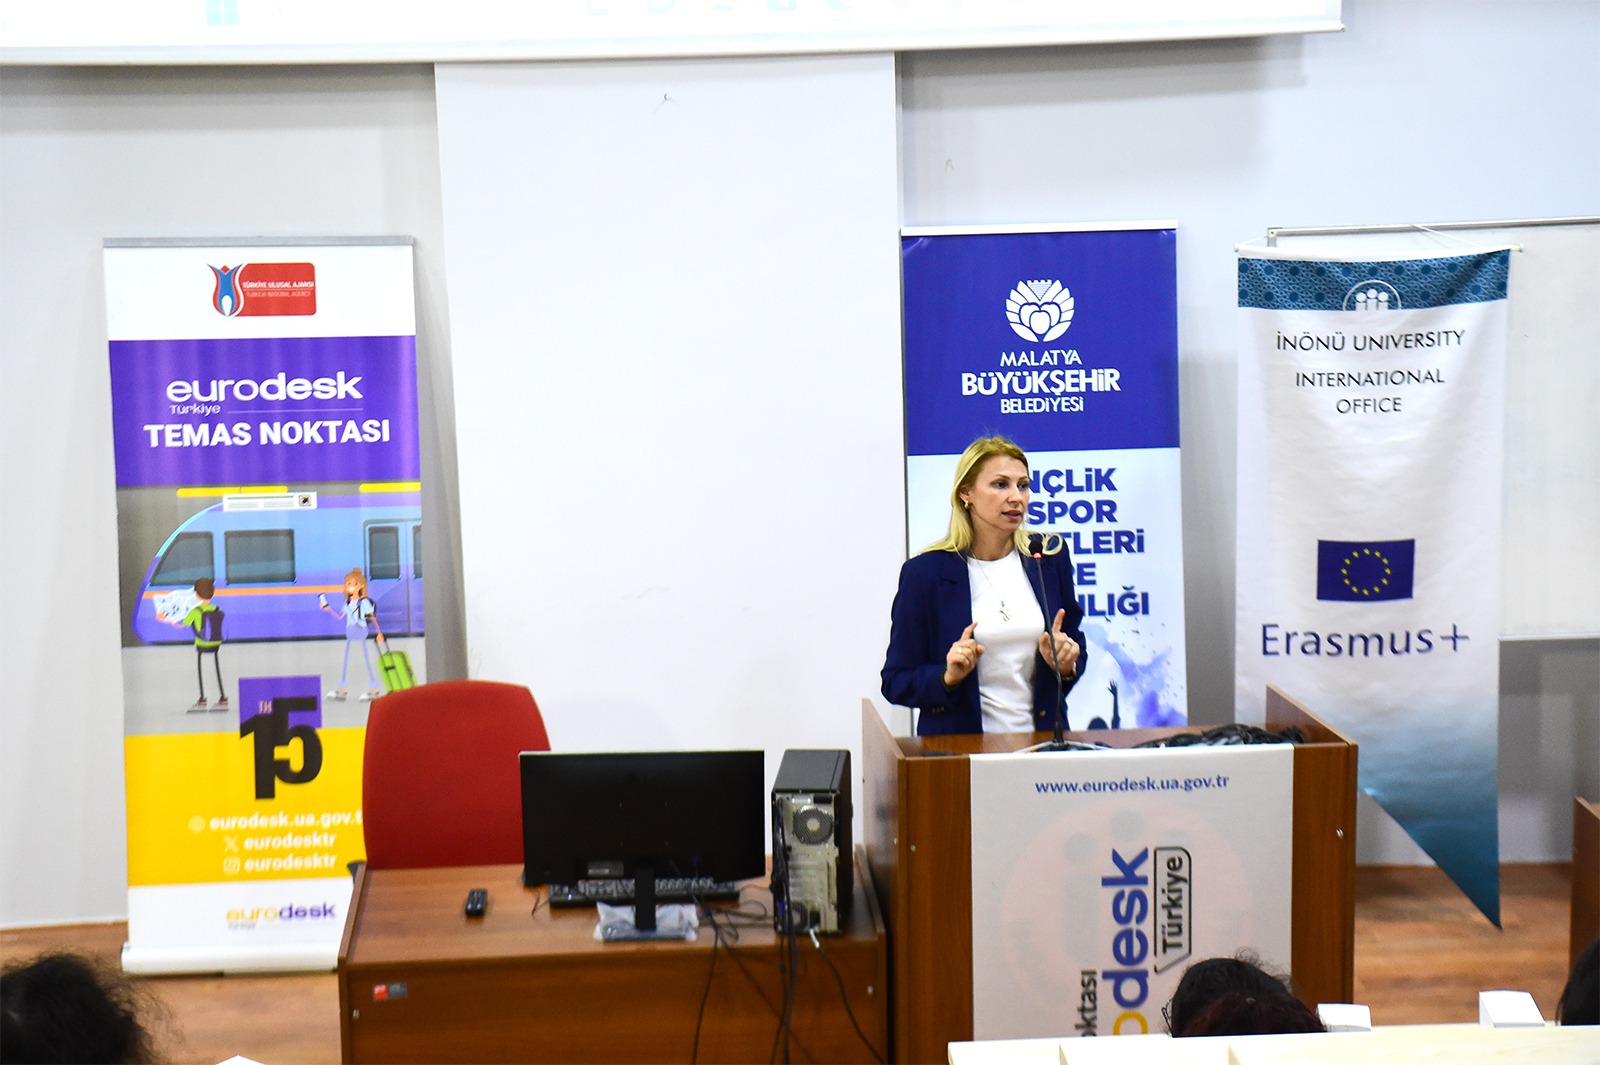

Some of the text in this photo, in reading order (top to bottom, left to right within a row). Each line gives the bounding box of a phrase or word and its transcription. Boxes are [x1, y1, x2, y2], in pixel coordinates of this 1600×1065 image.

[1277, 330, 1466, 351] İNÖNÜ UNIVERSITY
[1000, 350, 1082, 367] MALATYA
[166, 371, 363, 402] eurodesk
[1296, 369, 1445, 387] INTERNATIONAL
[1336, 398, 1402, 414] OFFICE
[143, 419, 390, 448] TEMAS NOKTASI
[1028, 500, 1118, 525] SPOR
[1261, 623, 1470, 658] Erasmus+
[240, 695, 324, 800] 15
[1035, 775, 1229, 793] www.eurodesk.ua.gov.tr
[209, 810, 363, 830] eurodesk.ua.gov.t
[243, 832, 336, 850] eurodesktr
[244, 854, 337, 871] eurodesktr
[226, 902, 335, 922] eurodesk
[1161, 856, 1187, 954] Türkiye
[1102, 847, 1149, 1035] odesk
